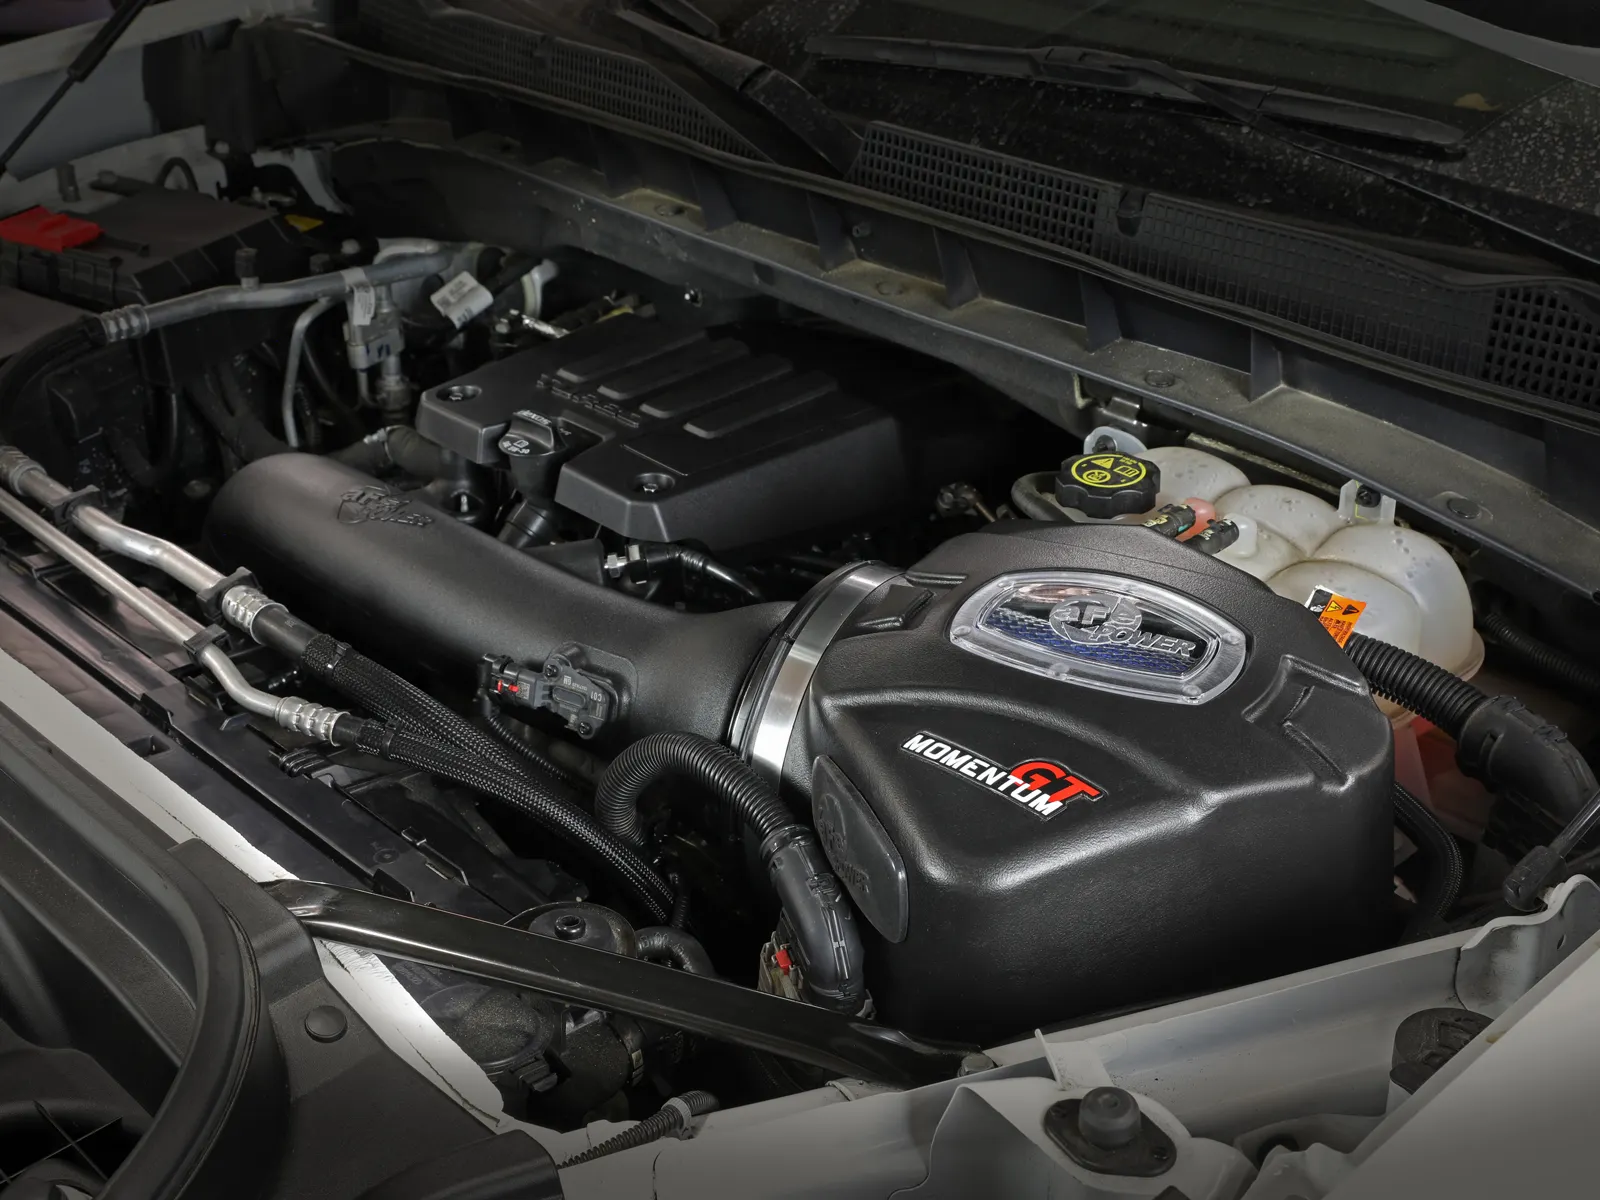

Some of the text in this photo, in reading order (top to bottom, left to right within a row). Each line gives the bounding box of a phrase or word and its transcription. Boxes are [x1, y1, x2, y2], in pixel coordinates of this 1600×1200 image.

[1091, 624, 1197, 658] POWER
[902, 733, 1064, 816] MOMENTUM
[1009, 760, 1101, 803] GT
